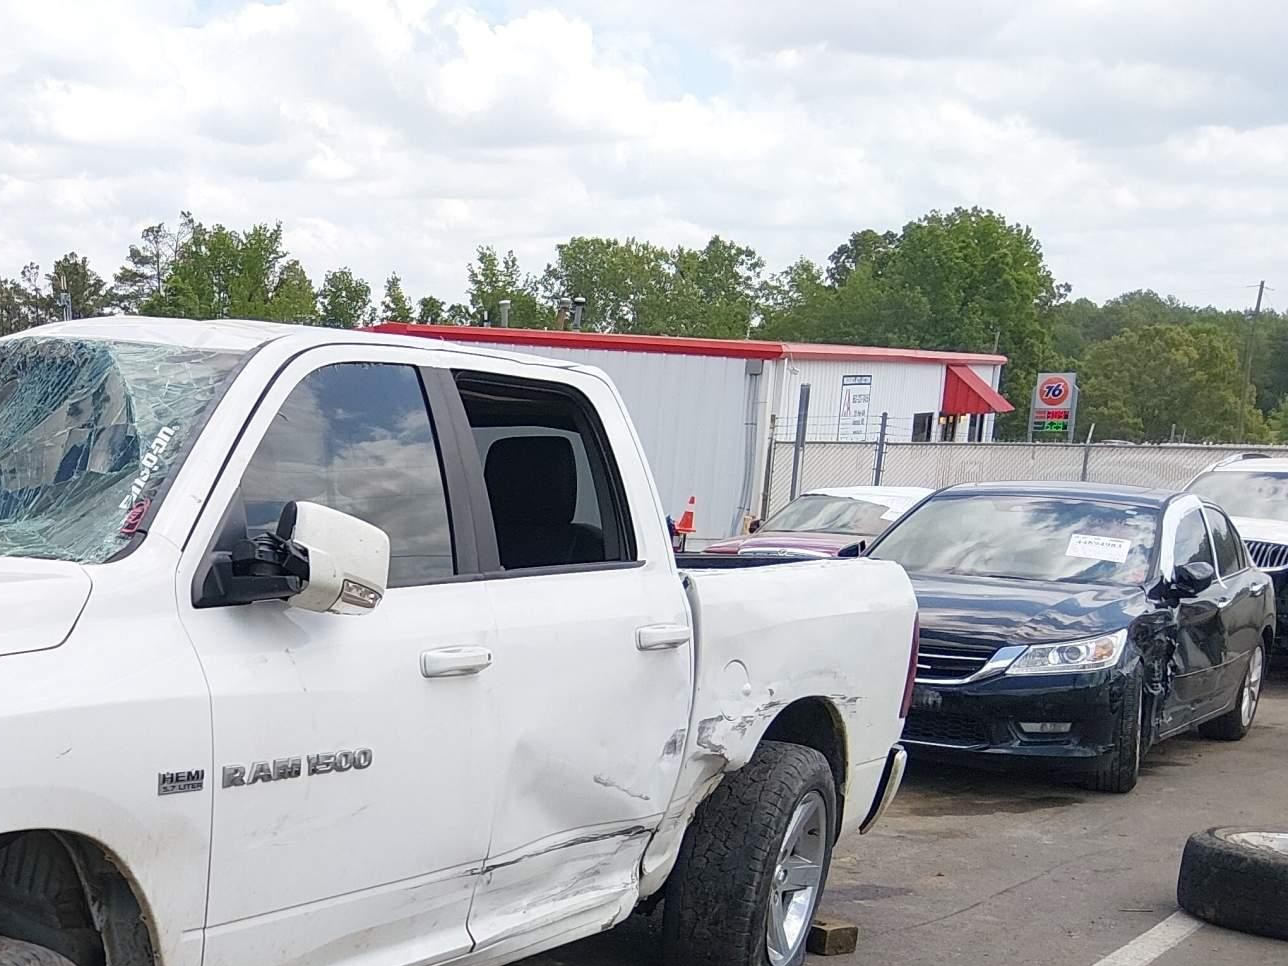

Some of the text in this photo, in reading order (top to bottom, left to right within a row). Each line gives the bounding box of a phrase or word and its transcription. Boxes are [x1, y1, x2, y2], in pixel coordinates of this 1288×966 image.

[1043, 383, 1064, 399] 76
[222, 748, 373, 789] RAM 1500
[162, 769, 205, 785] HEMI
[178, 782, 203, 792] LITER
